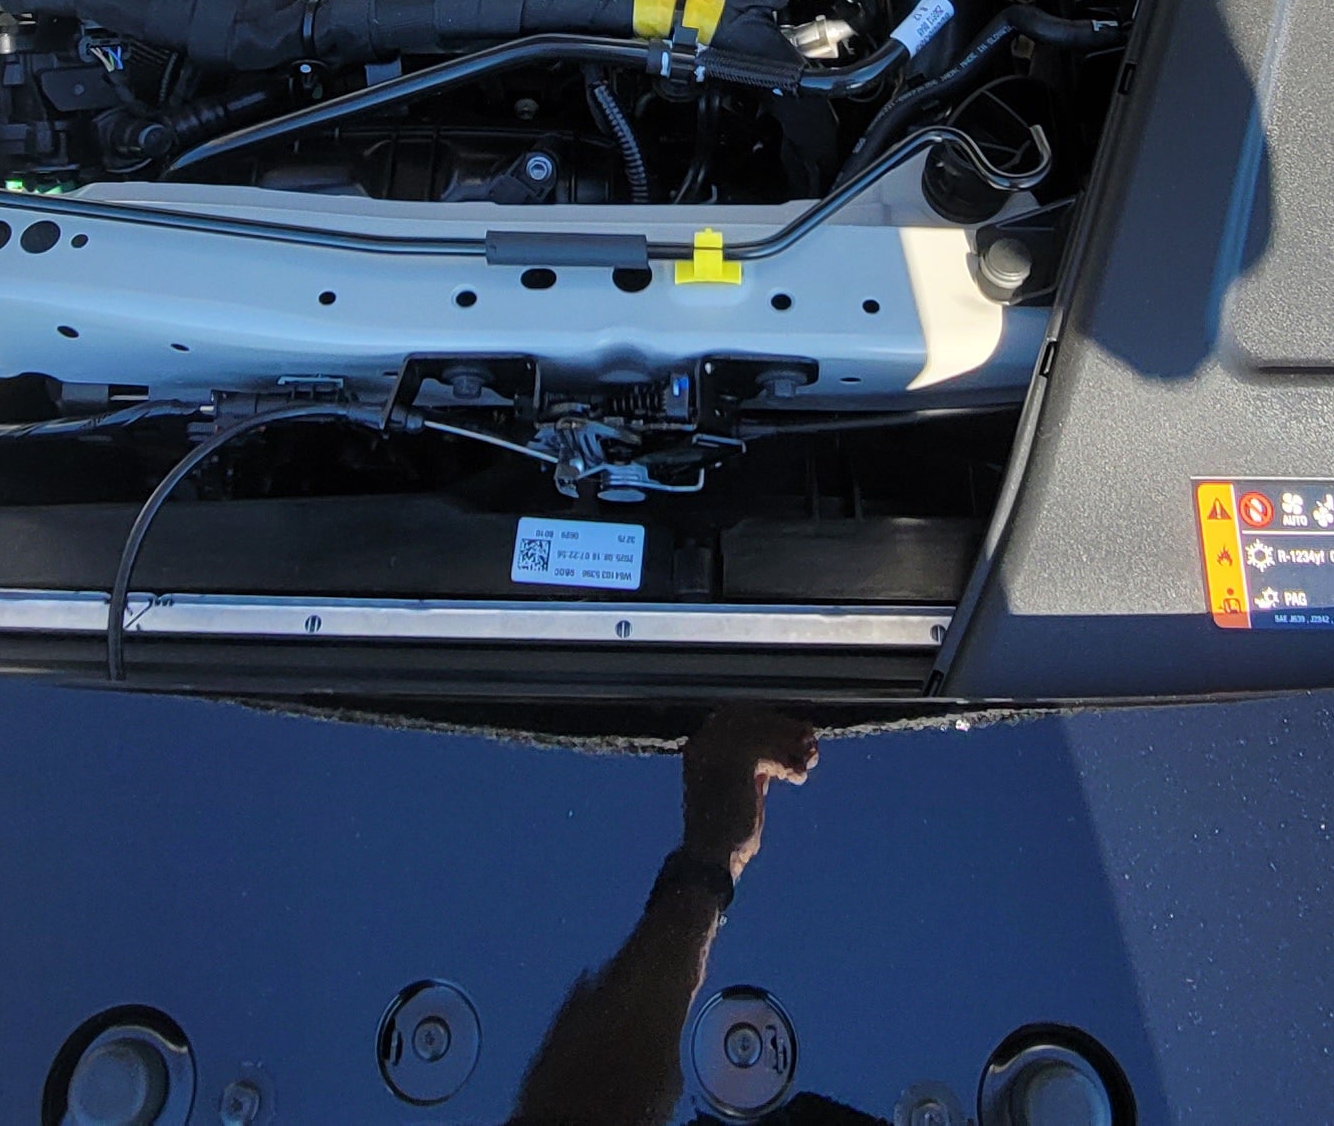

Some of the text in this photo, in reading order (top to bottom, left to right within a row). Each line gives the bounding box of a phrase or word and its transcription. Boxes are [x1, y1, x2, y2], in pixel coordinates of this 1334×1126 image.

[1282, 515, 1308, 526] AUTO
[1277, 549, 1325, 566] R-1234yf
[1284, 591, 1308, 606] PAG
